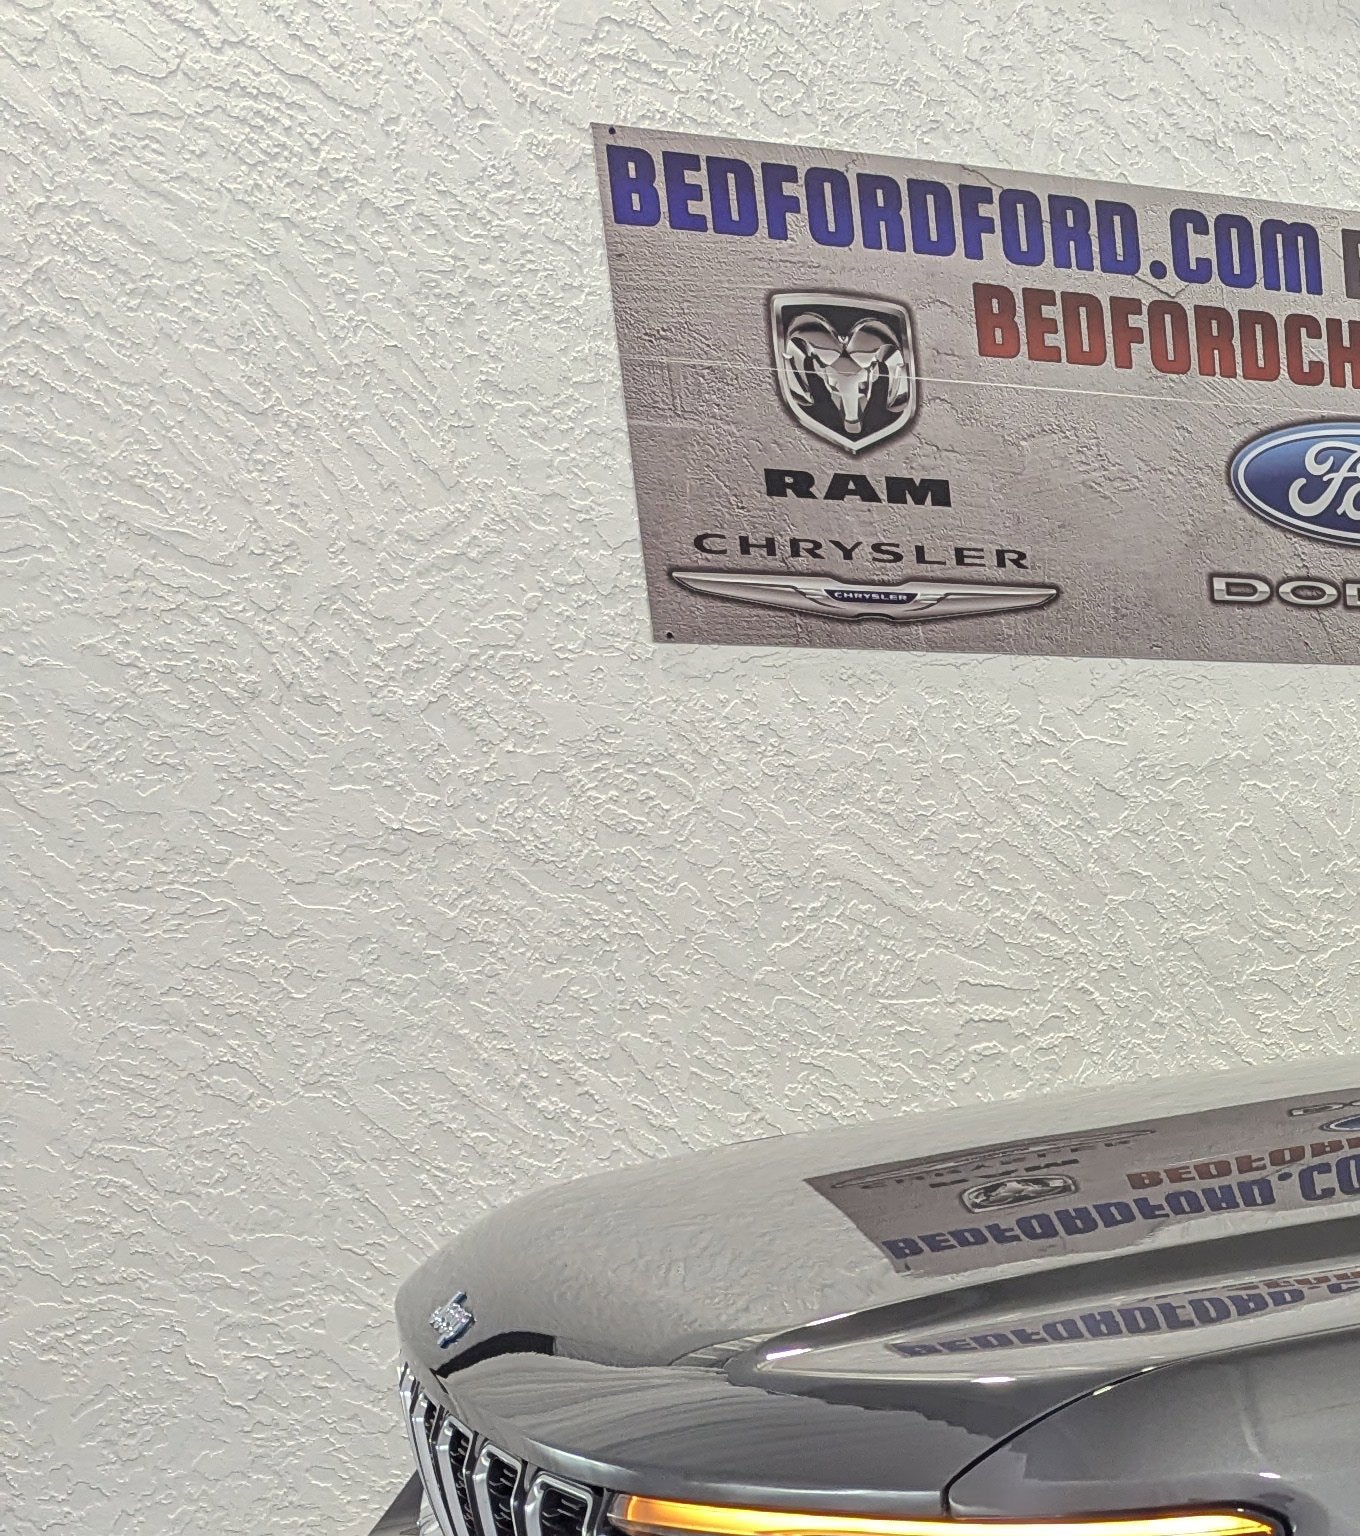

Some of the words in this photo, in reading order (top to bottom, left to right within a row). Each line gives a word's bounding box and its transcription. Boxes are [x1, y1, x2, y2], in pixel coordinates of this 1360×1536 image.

[605, 143, 1322, 296] BEDFORDFORD.COM
[763, 467, 953, 508] RAM
[693, 532, 1031, 571] CHRYSLER
[833, 591, 908, 602] CHRYSLER
